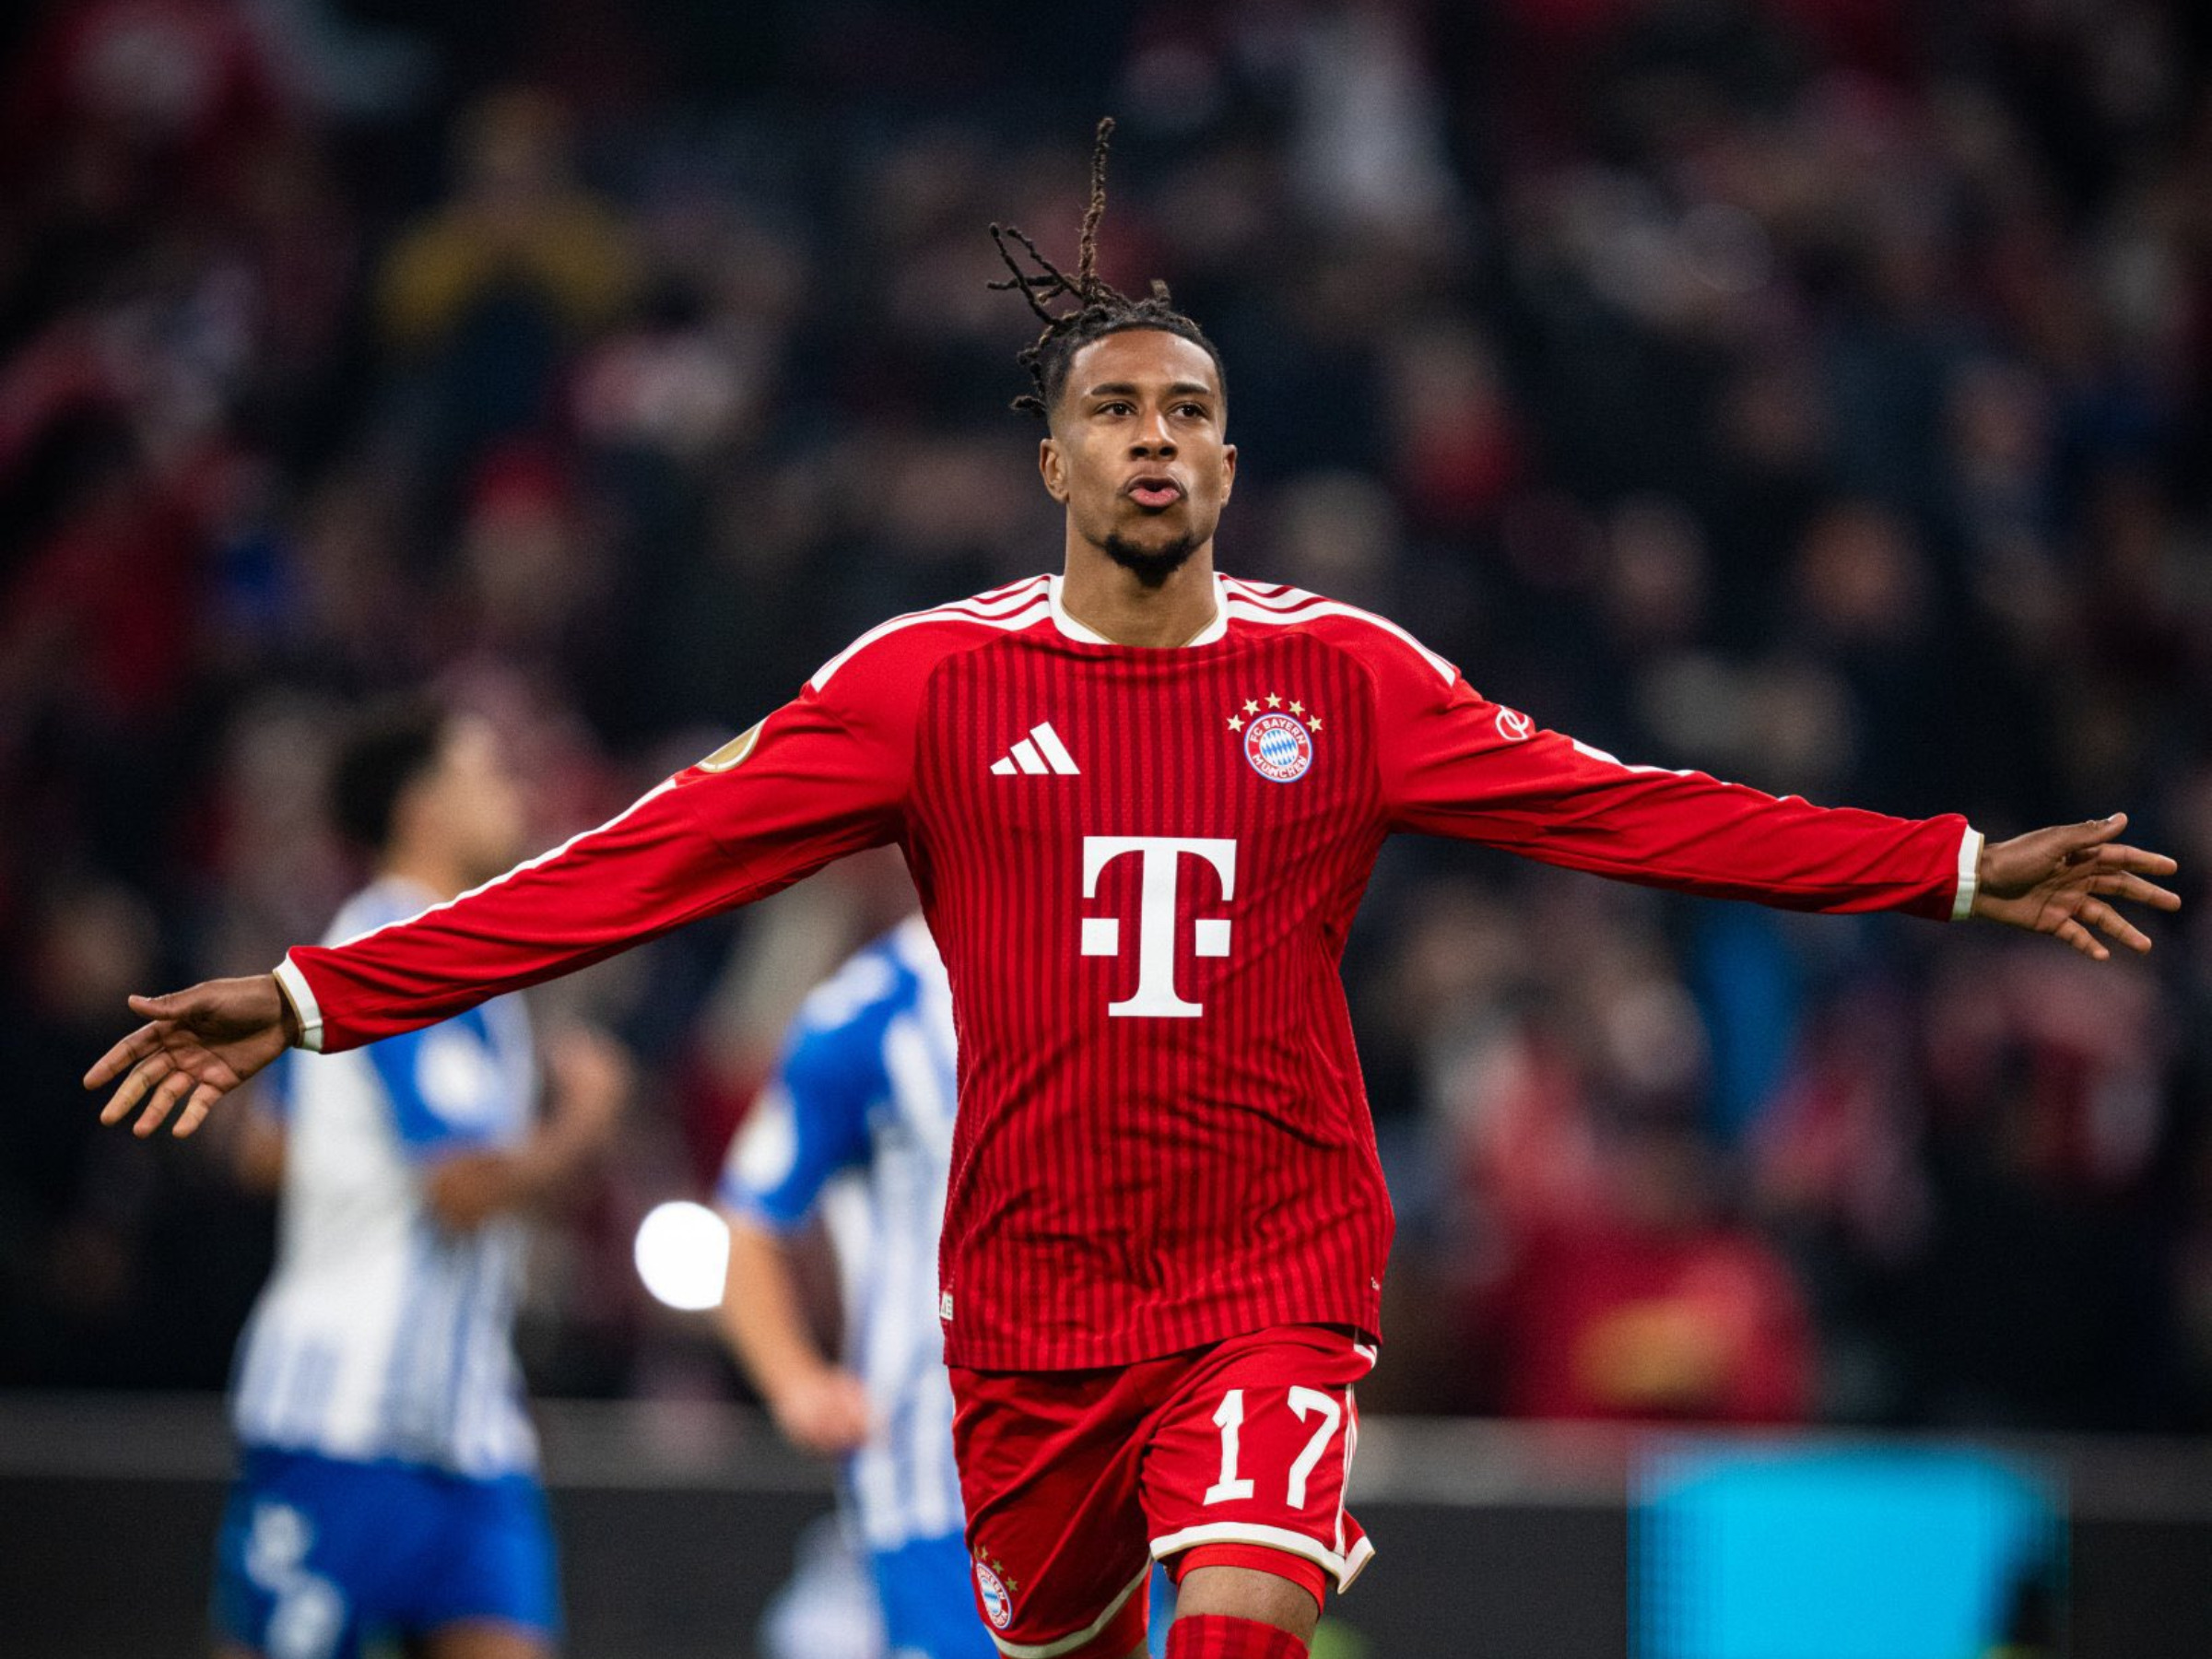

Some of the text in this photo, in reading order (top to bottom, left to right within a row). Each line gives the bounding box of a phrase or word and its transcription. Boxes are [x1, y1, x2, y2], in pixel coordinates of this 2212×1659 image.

[1250, 719, 1306, 745] FC BAYERN
[1081, 836, 1237, 1018] T
[1203, 1385, 1341, 1511] 17
